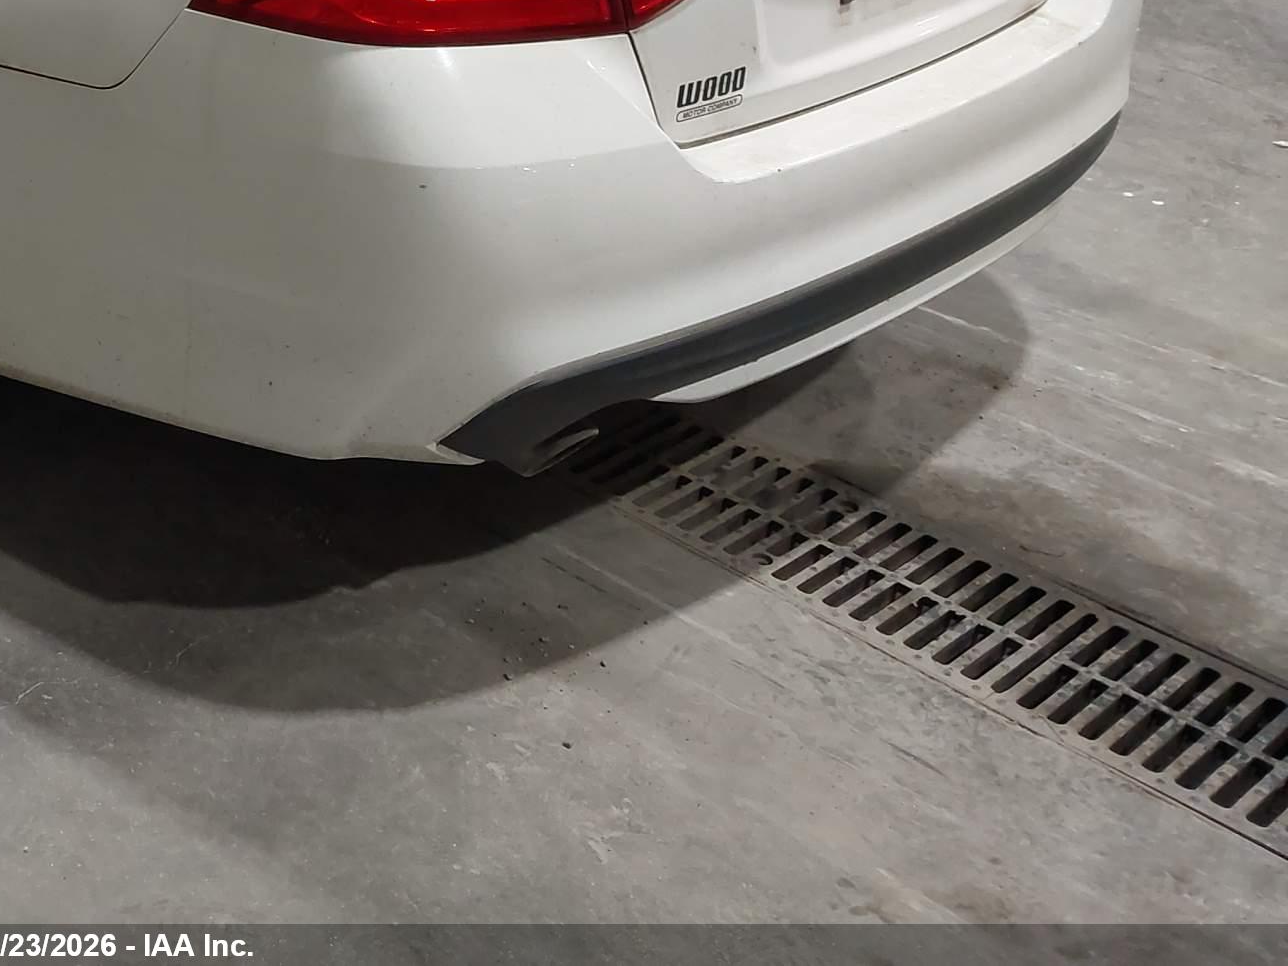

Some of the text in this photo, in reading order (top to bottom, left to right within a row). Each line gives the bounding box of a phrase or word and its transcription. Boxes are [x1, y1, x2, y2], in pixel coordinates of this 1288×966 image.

[677, 66, 747, 108] WOOD
[682, 98, 738, 119] MOTOR COMPANY
